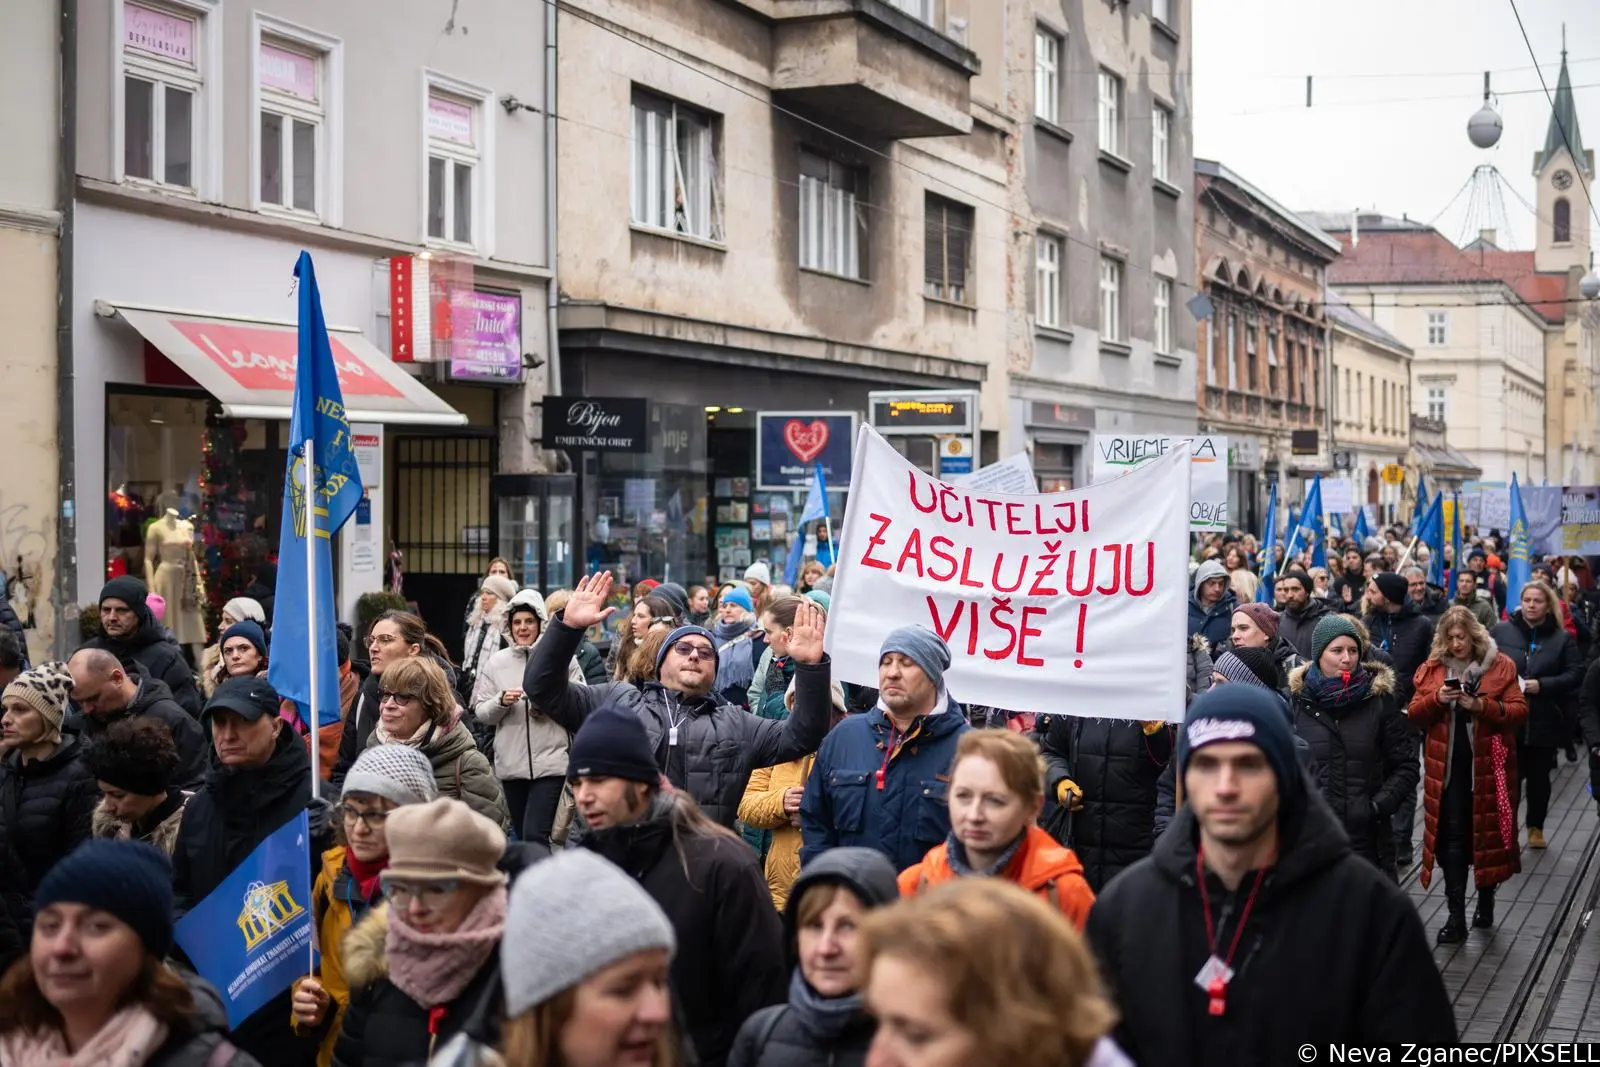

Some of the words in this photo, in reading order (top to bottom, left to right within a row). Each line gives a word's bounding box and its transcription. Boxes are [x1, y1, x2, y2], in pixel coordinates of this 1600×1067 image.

[555, 434, 607, 447] UMJETNIČKI
[608, 437, 633, 448] OBRT
[566, 400, 623, 435] Bijou
[1099, 438, 1171, 463] VRIJEME
[908, 470, 1090, 535] UČITELJI
[860, 513, 1155, 598] ZASLUŽUJU
[926, 595, 1048, 667] VIŠE
[1073, 603, 1089, 669] !
